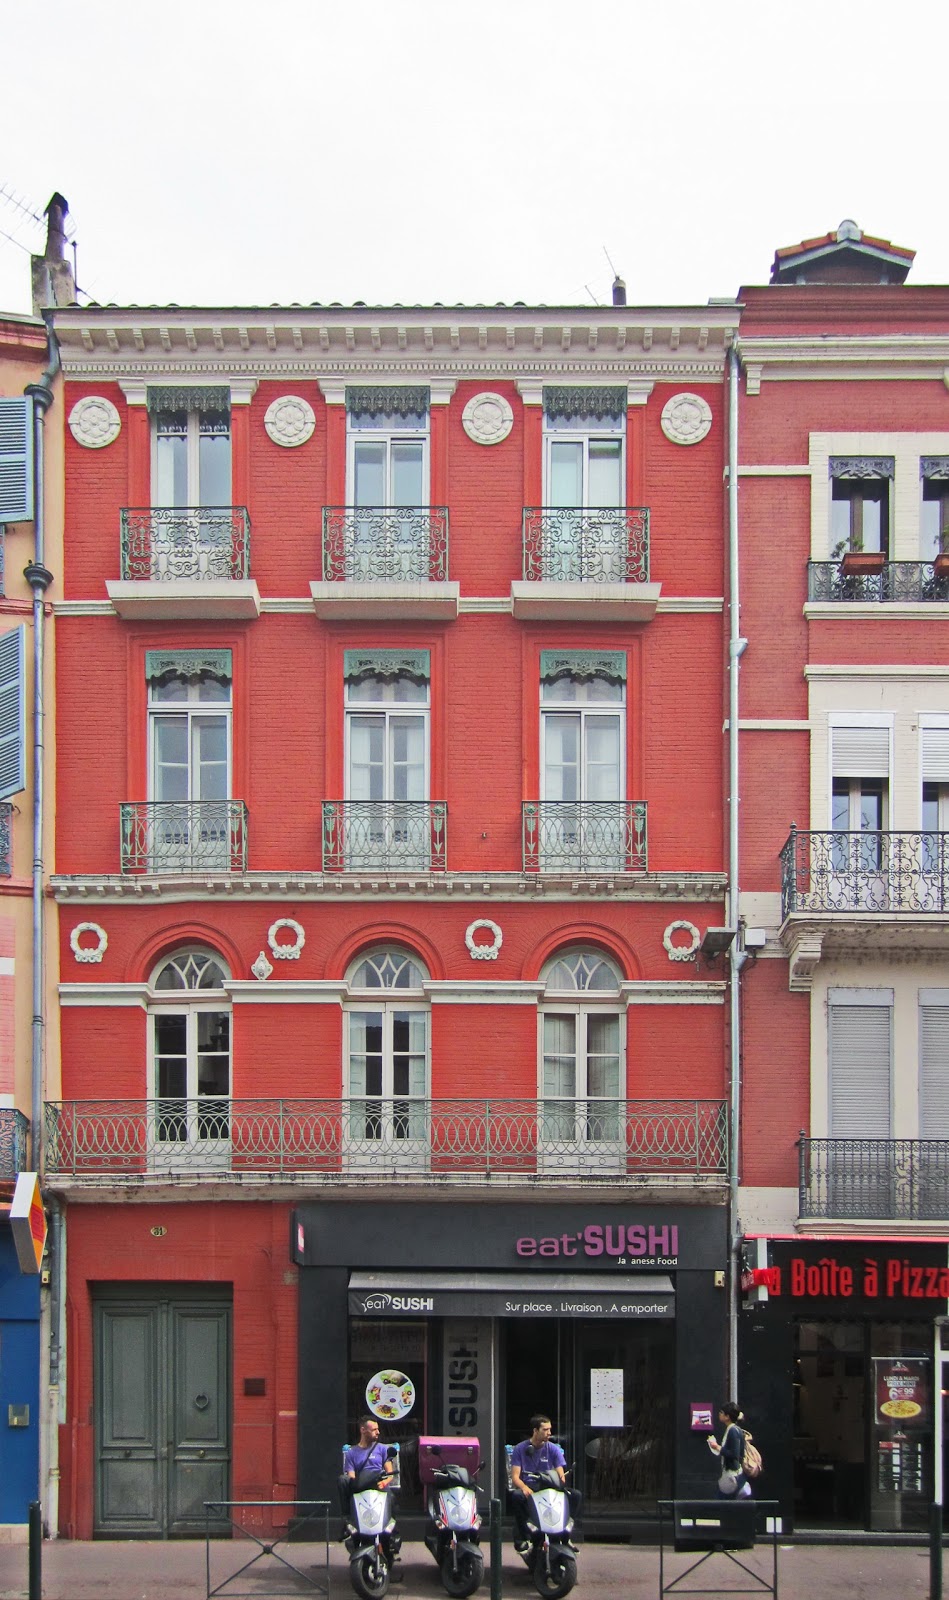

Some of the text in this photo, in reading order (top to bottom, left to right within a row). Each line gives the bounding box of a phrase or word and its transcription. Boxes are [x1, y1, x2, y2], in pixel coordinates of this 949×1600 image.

[657, 1257, 678, 1265] Food
[791, 1258, 853, 1296] Boîte
[864, 1258, 878, 1297] à
[392, 1298, 434, 1311] SUSHI
[505, 1302, 668, 1315] Sur place Livraison A emporter
